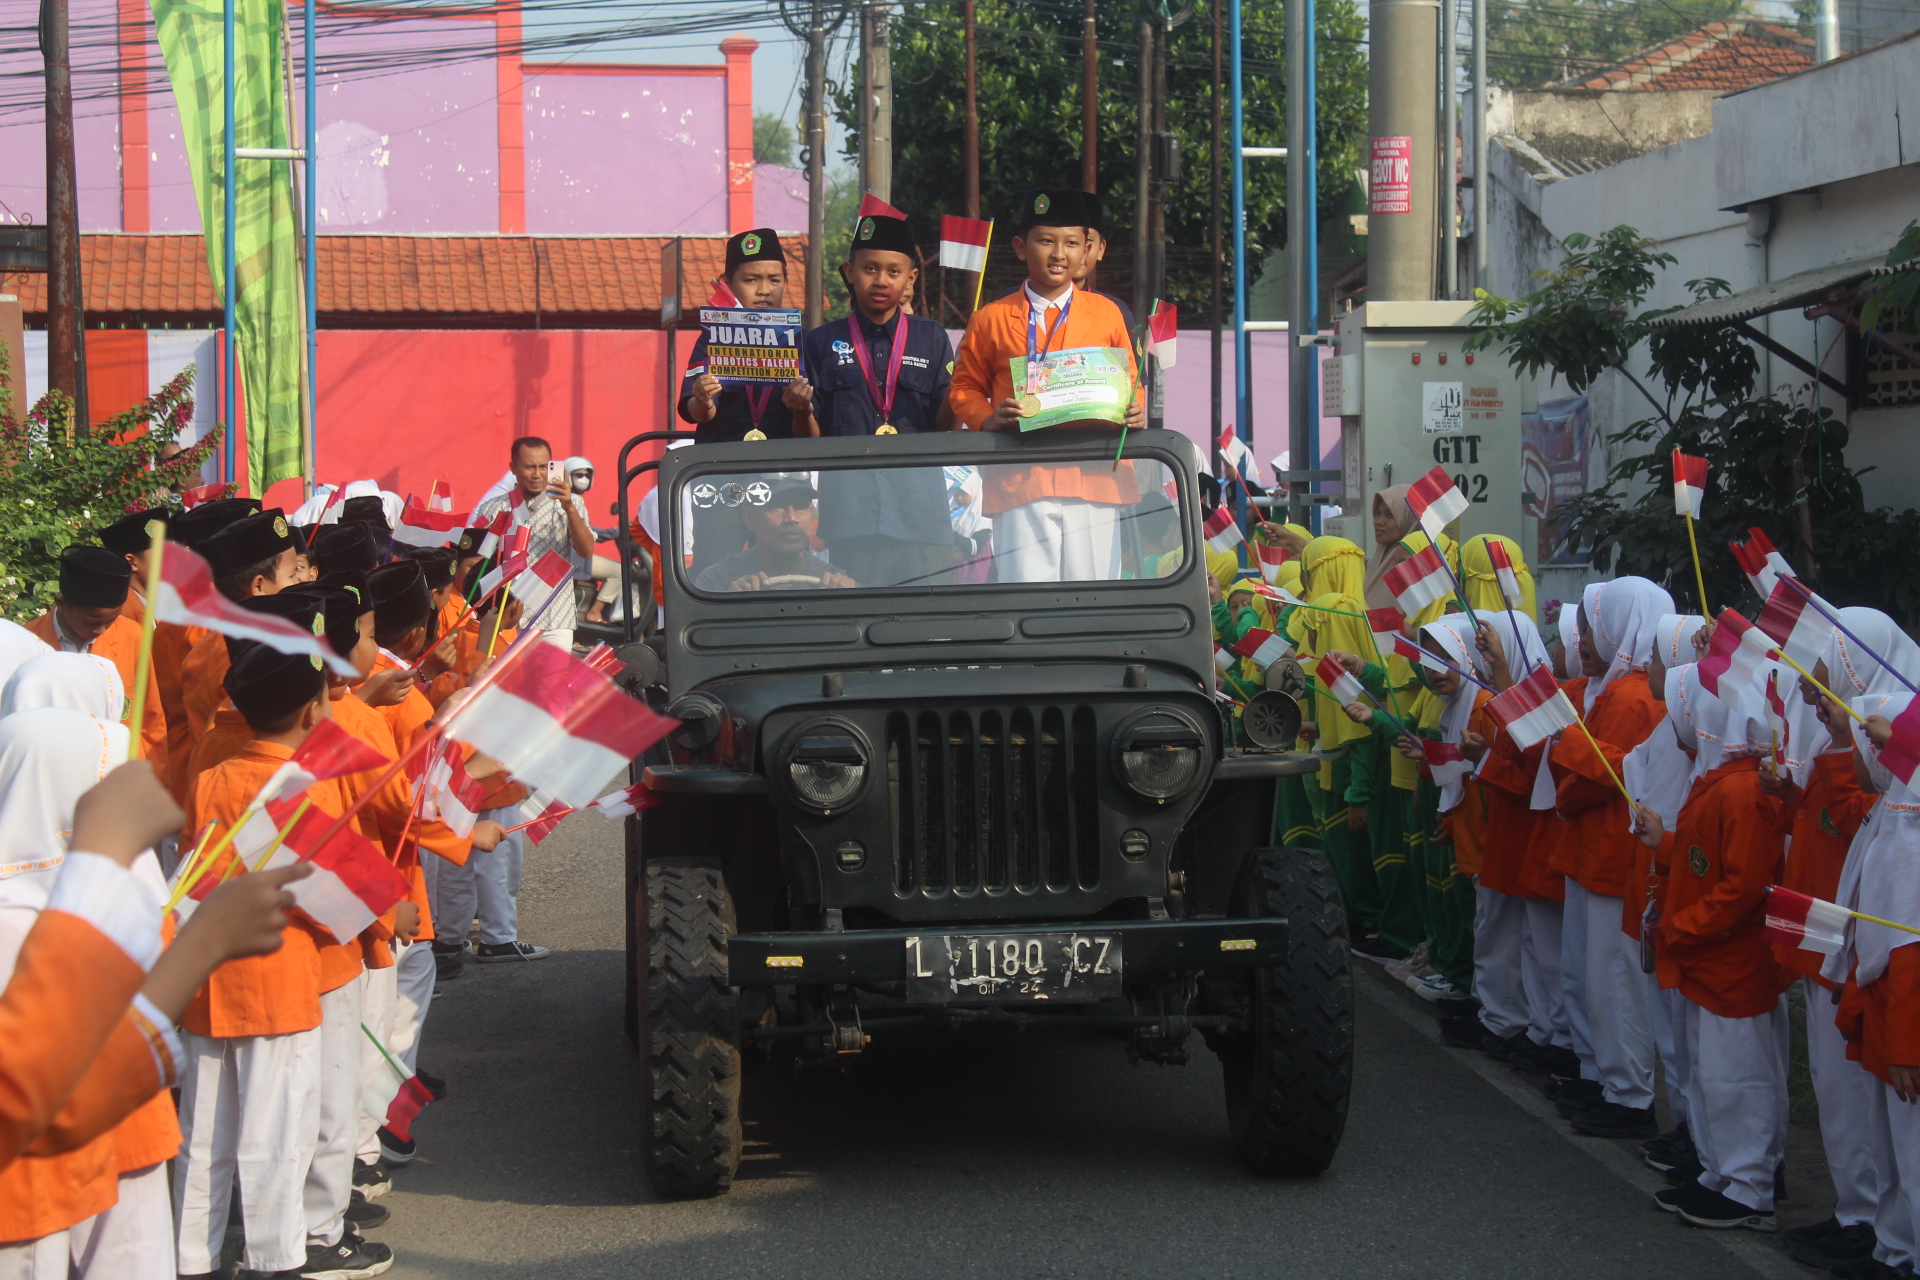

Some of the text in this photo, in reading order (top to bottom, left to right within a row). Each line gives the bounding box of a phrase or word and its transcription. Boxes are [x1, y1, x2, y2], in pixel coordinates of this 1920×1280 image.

[1390, 140, 1406, 148] MULYA
[1372, 158, 1409, 183] SEDOT WC
[709, 326, 795, 346] JUARA 1
[709, 346, 796, 358] INTERNATIONAL
[710, 356, 796, 368] ROBOTICS TALENT
[711, 365, 796, 377] COMPETITION 2024
[1042, 380, 1076, 390] Certificate
[1433, 435, 1481, 464] GTT
[916, 938, 1112, 978] L 1180 CZ
[1020, 982, 1040, 994] 24
